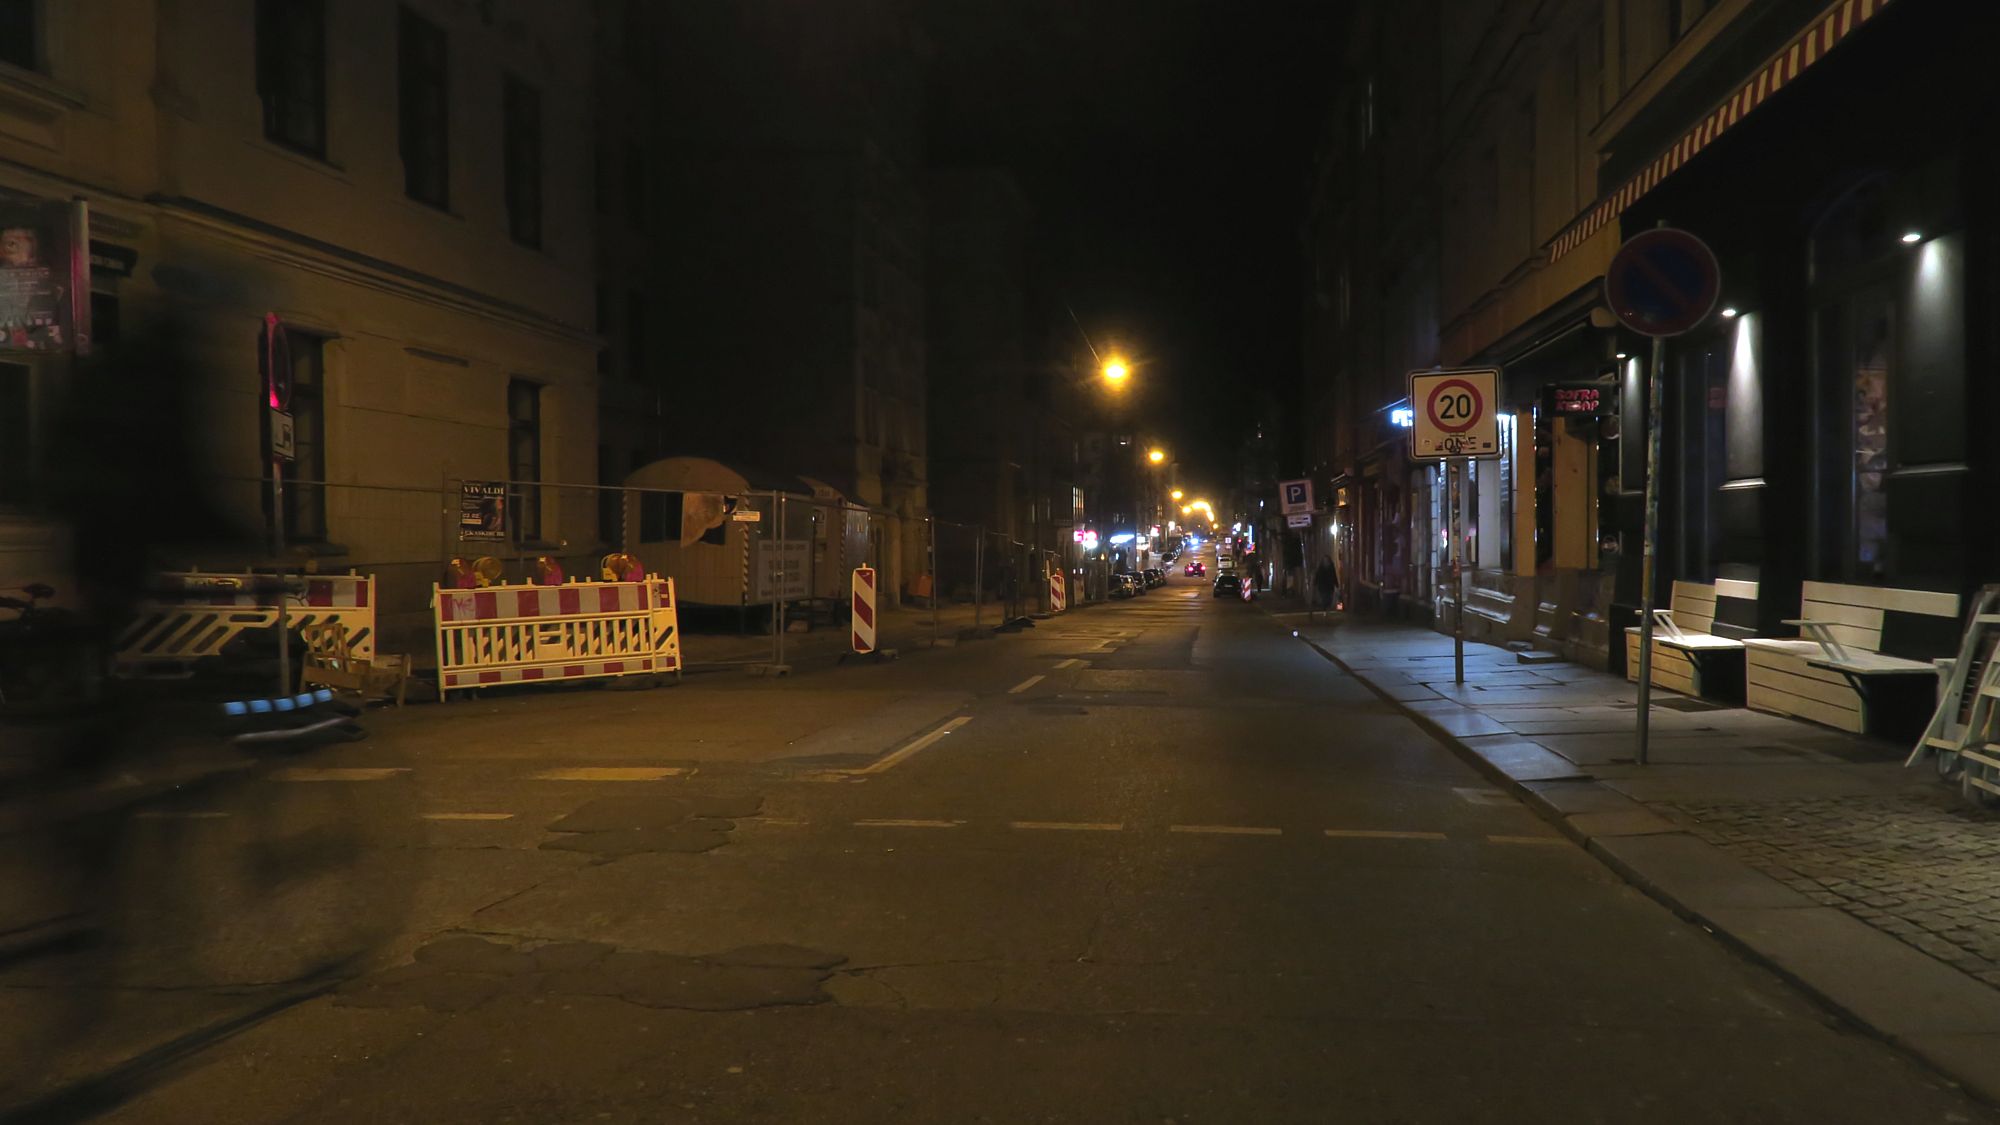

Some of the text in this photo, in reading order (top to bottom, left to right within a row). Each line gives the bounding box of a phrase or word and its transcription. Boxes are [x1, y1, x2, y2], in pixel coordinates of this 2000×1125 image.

[1554, 388, 1600, 400] SOFRA
[1439, 394, 1471, 419] 20
[463, 486, 504, 495] VIVALDI
[1290, 486, 1302, 502] P
